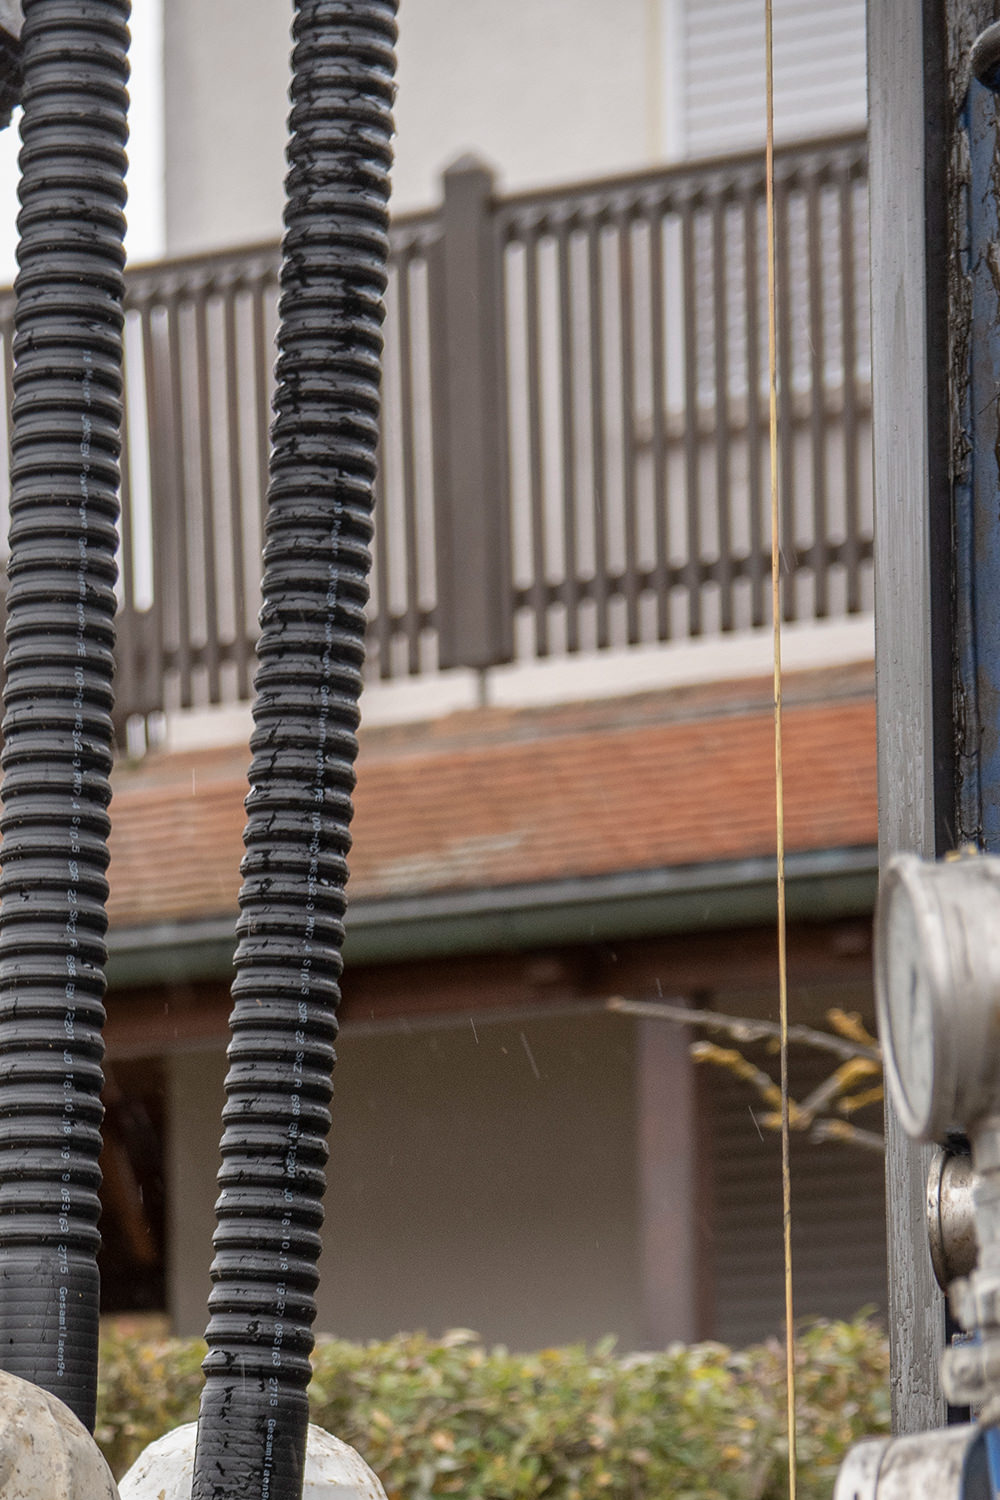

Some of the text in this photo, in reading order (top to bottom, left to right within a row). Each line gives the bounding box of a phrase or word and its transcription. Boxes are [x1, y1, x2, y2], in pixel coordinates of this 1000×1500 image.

[66, 860, 80, 882] SDR
[66, 888, 78, 904] 22
[65, 909, 78, 934] SKZ
[64, 981, 75, 999] EN
[62, 1005, 76, 1040] 12201
[295, 1001, 309, 1024] SDR
[293, 1029, 305, 1045] 22
[286, 1121, 298, 1138] EN
[283, 1143, 298, 1179] 12201
[55, 1243, 69, 1274] 2715
[55, 1285, 69, 1377] Gesamtlaenge
[269, 1322, 284, 1367] 093163
[265, 1376, 280, 1407] 2715
